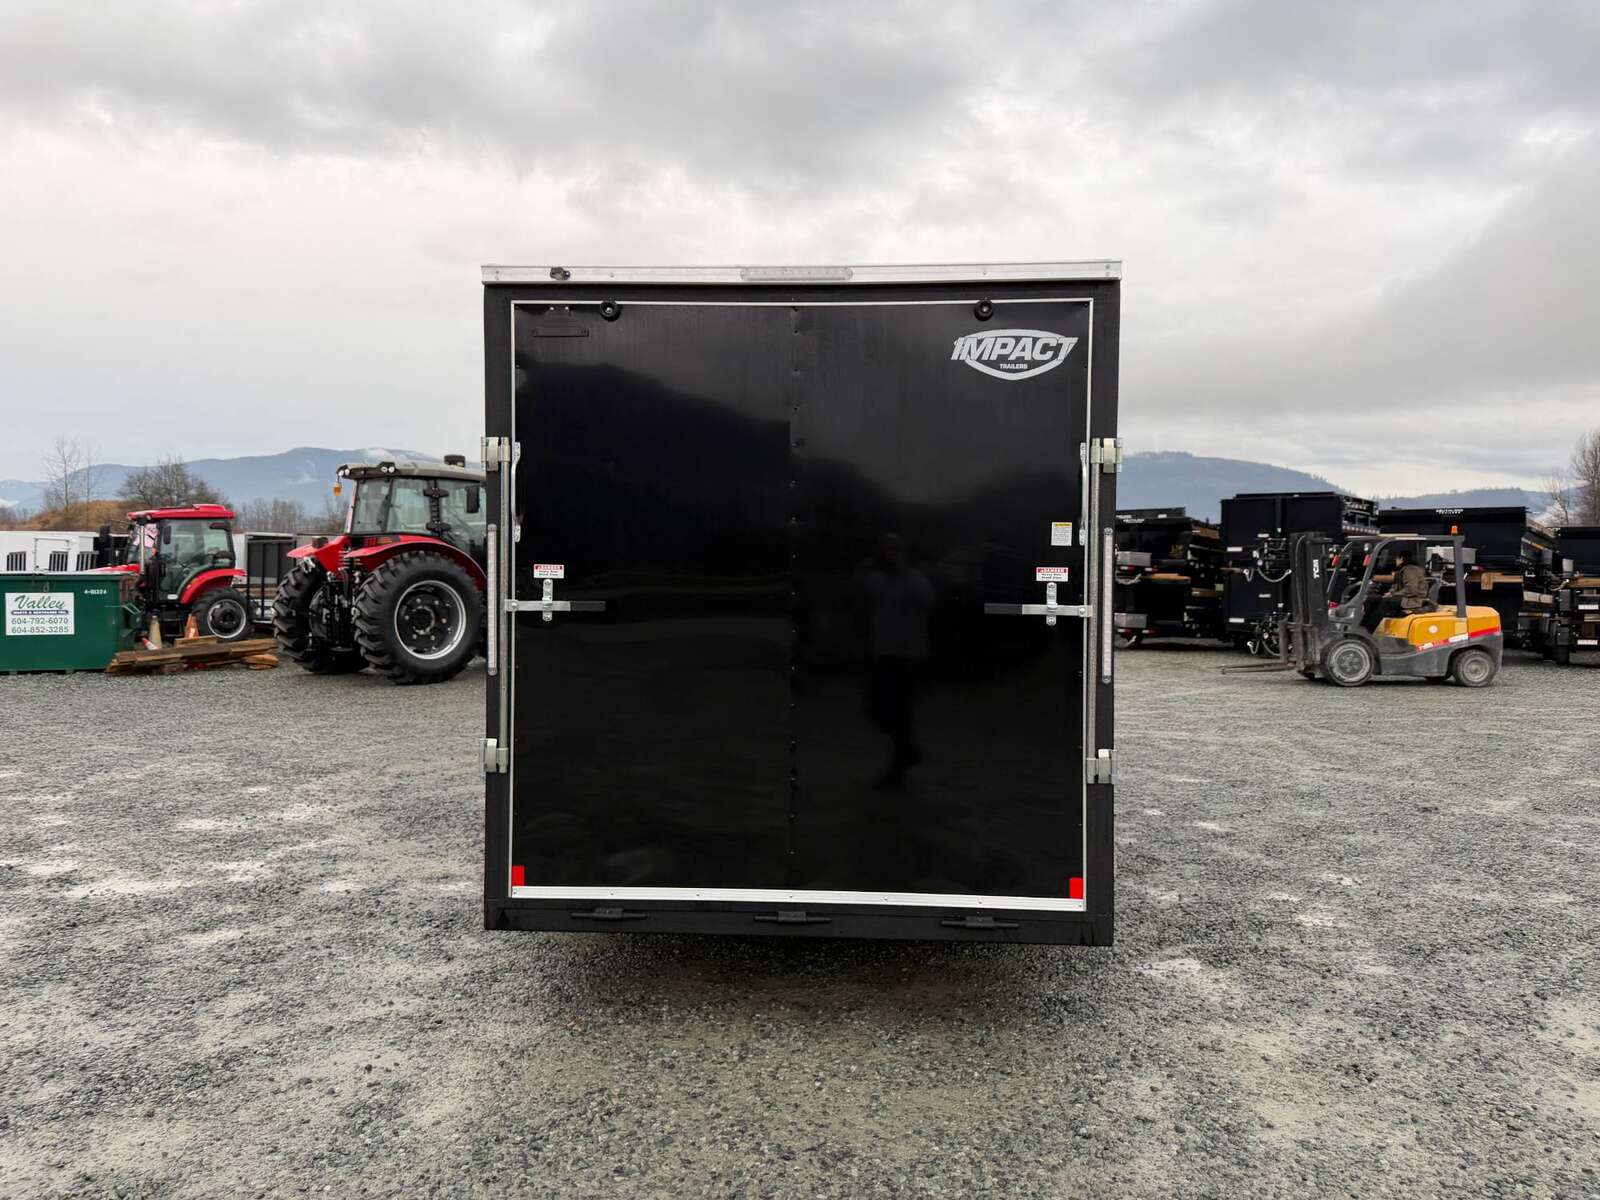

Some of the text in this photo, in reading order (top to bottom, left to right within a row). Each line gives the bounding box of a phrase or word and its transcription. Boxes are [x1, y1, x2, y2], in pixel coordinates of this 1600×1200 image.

[951, 337, 1078, 361] IMPACT
[14, 594, 65, 609] Valley
[11, 617, 69, 625] 604-792-6070
[11, 626, 69, 634] 604-852-3285
